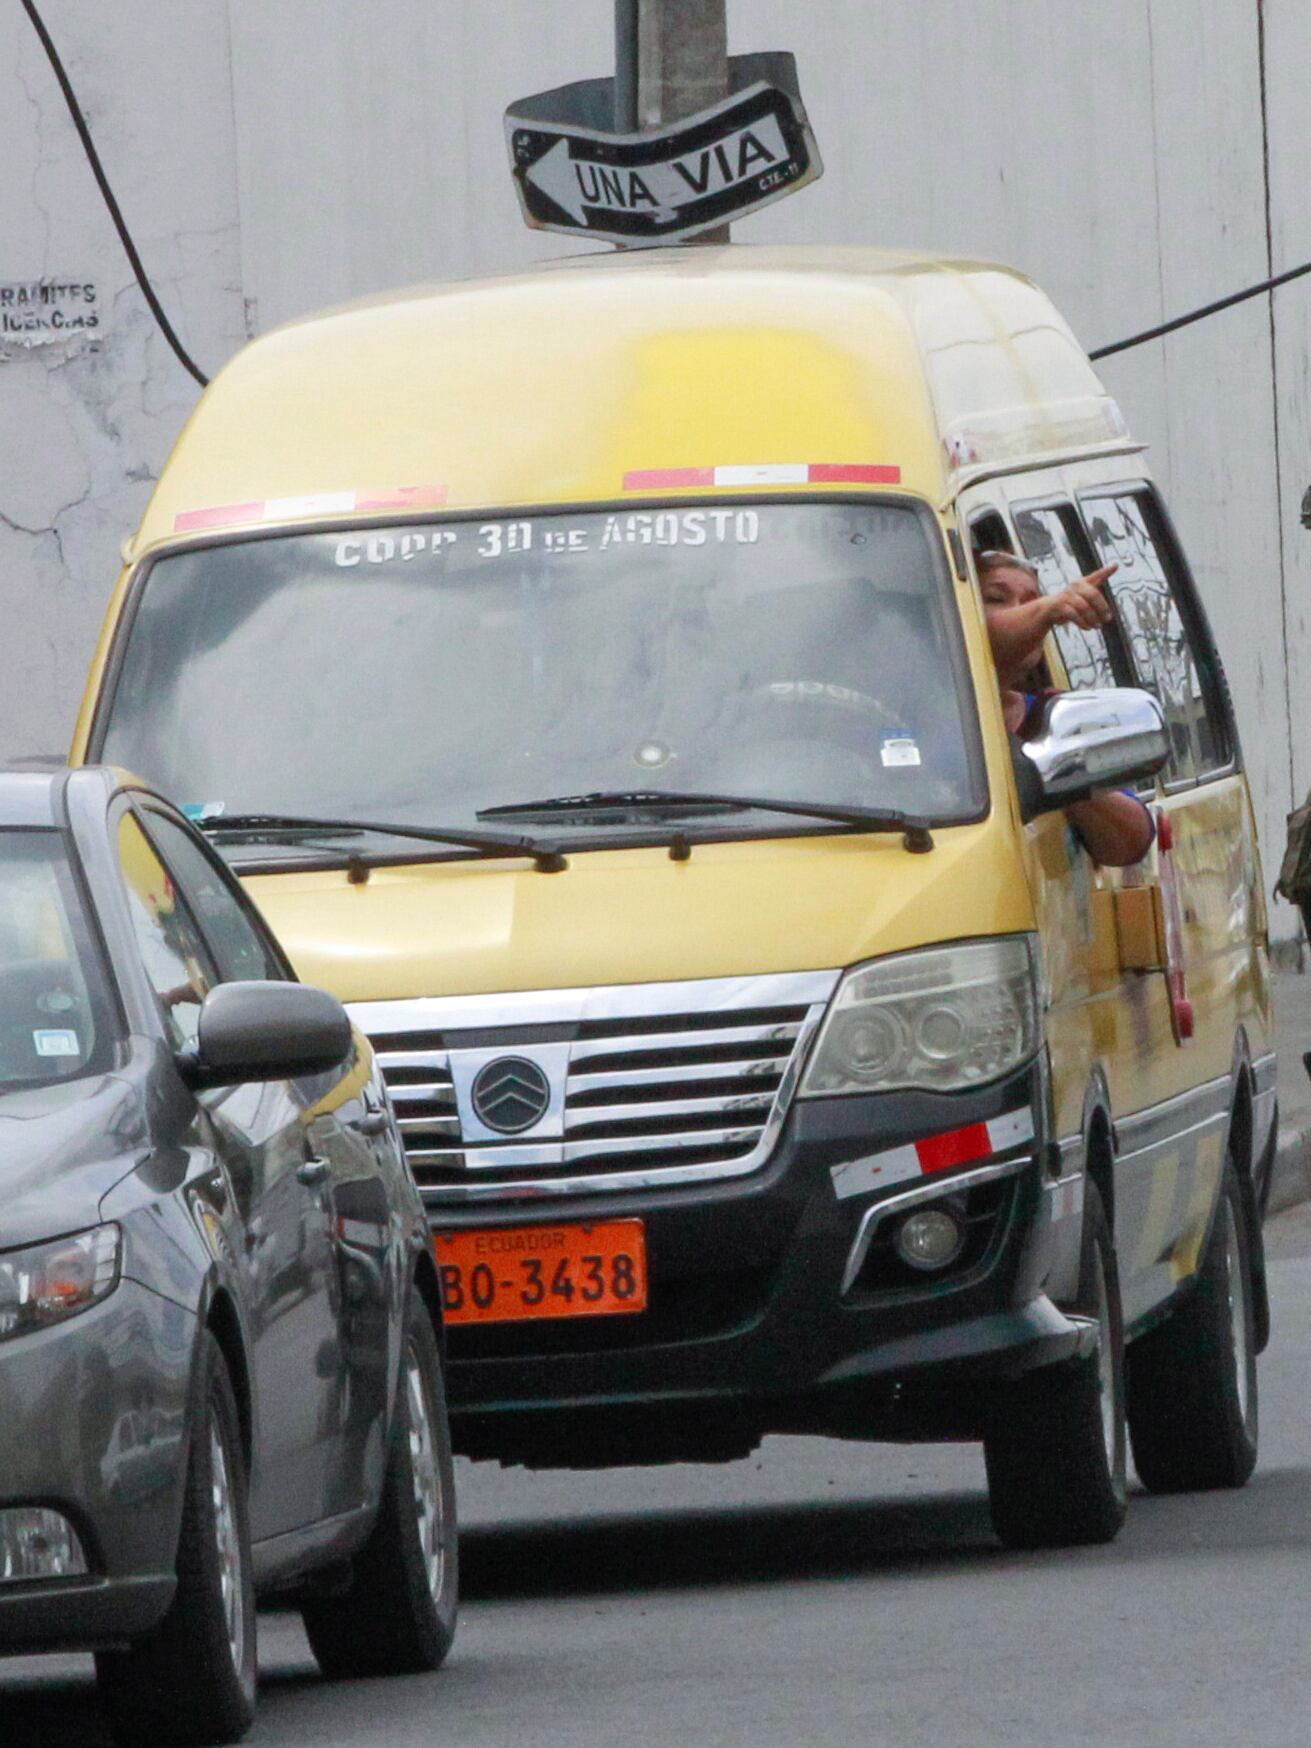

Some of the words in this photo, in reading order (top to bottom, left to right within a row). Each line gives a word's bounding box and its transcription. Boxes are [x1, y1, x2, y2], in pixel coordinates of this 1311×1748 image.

[574, 162, 659, 207] UNA
[672, 131, 776, 195] VIA
[477, 522, 532, 557] 30
[545, 530, 588, 553] DE
[599, 511, 760, 550] AGOSTO
[474, 1232, 566, 1254] ECUADOR
